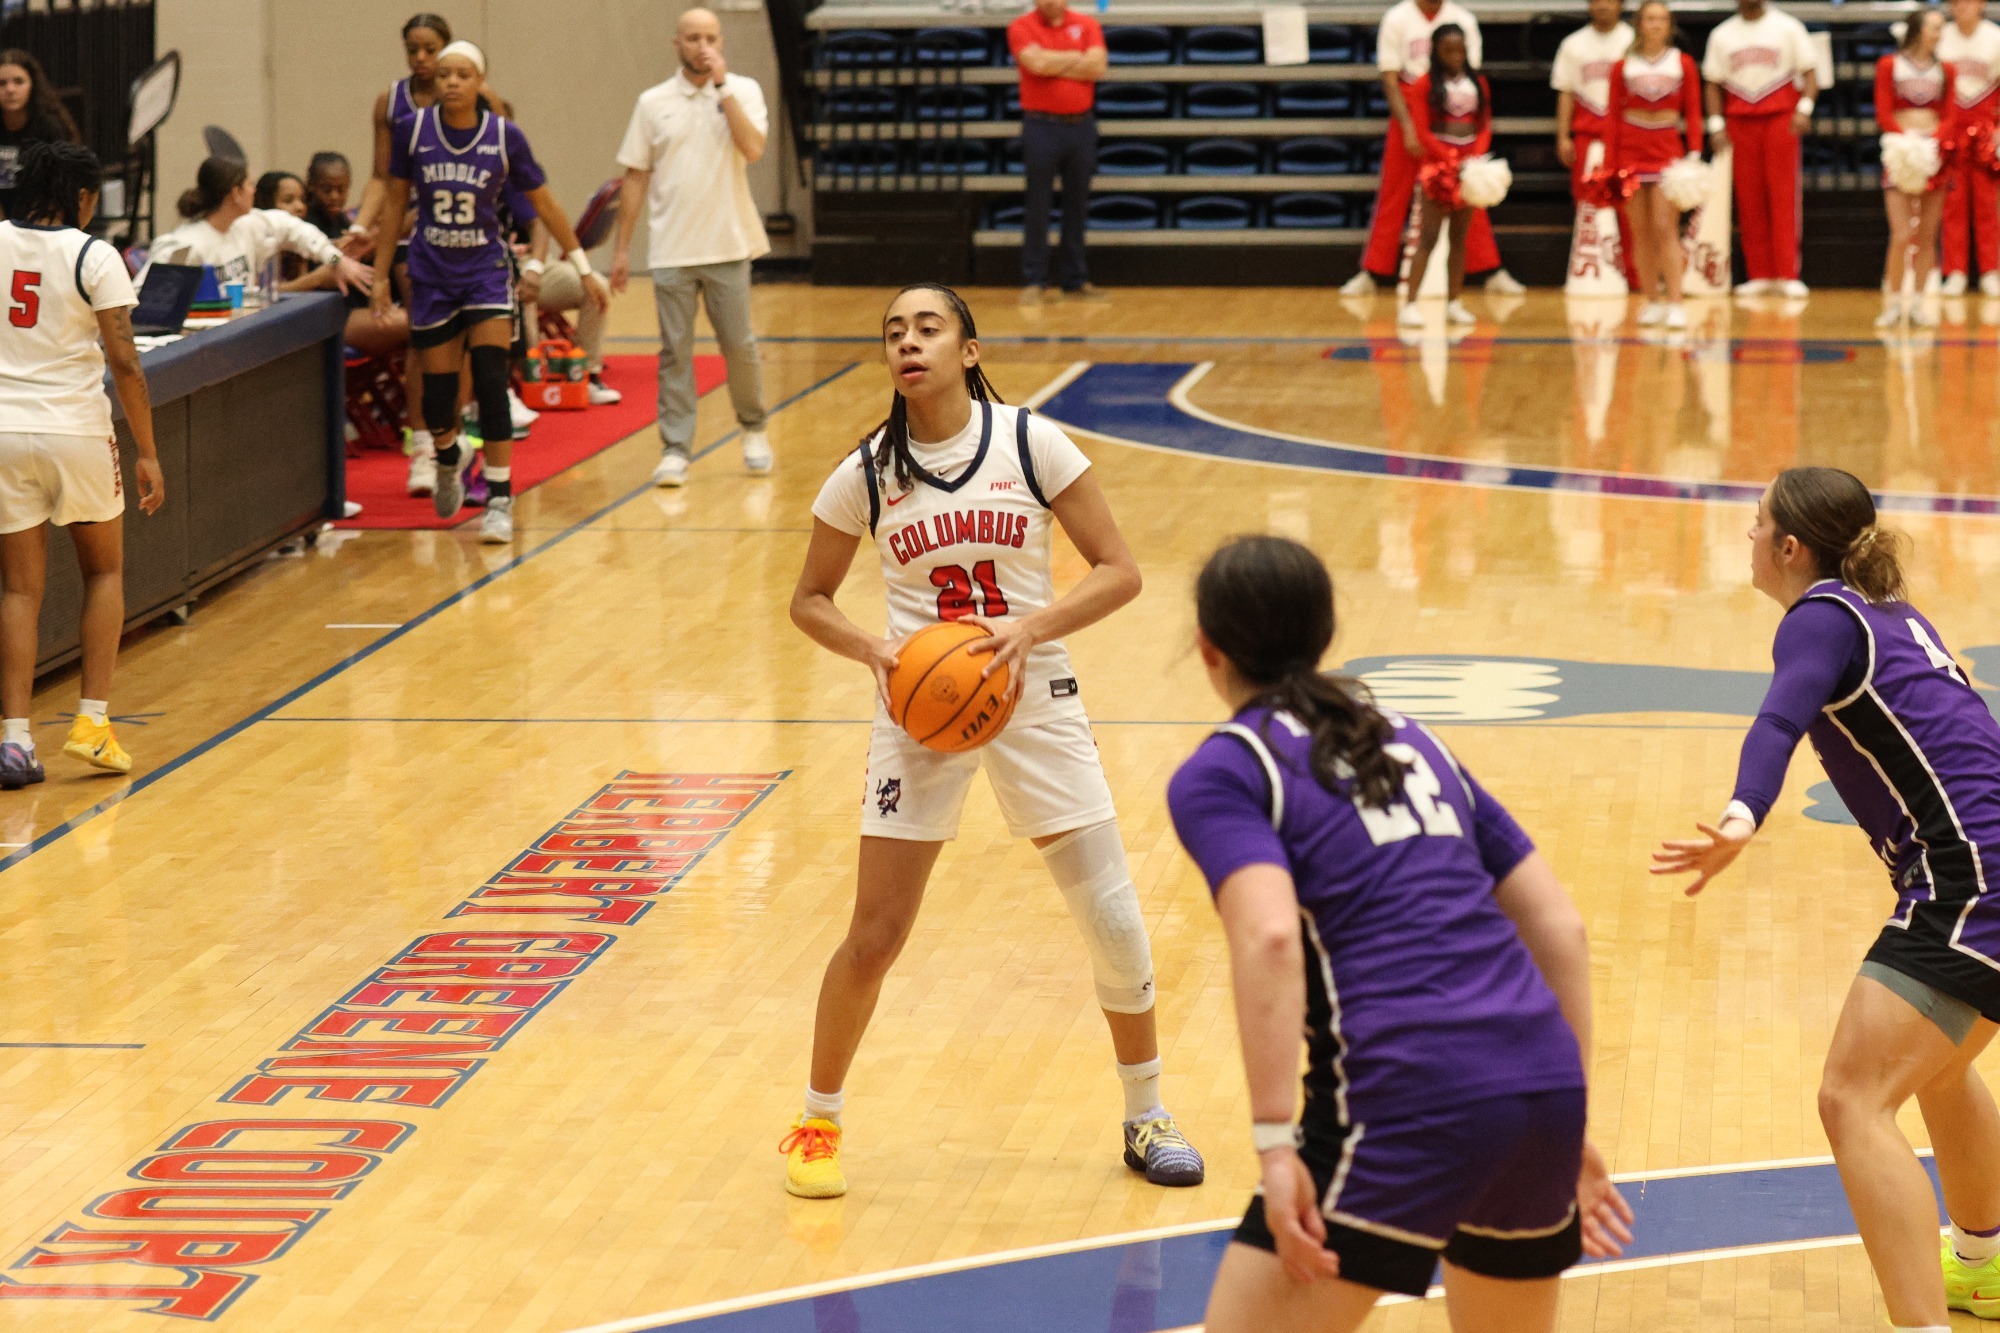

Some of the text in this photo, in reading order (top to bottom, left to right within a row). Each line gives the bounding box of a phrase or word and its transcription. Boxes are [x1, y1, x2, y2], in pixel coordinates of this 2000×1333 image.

[422, 161, 491, 189] MIDDLE
[432, 189, 476, 225] 23
[9, 269, 41, 329] 5
[990, 481, 1017, 491] PBC
[889, 510, 1028, 565] COLUMBUS
[929, 560, 1009, 622] 21
[1905, 618, 1967, 685] 4
[0, 769, 794, 1323] HERBERT GREENE COURT
